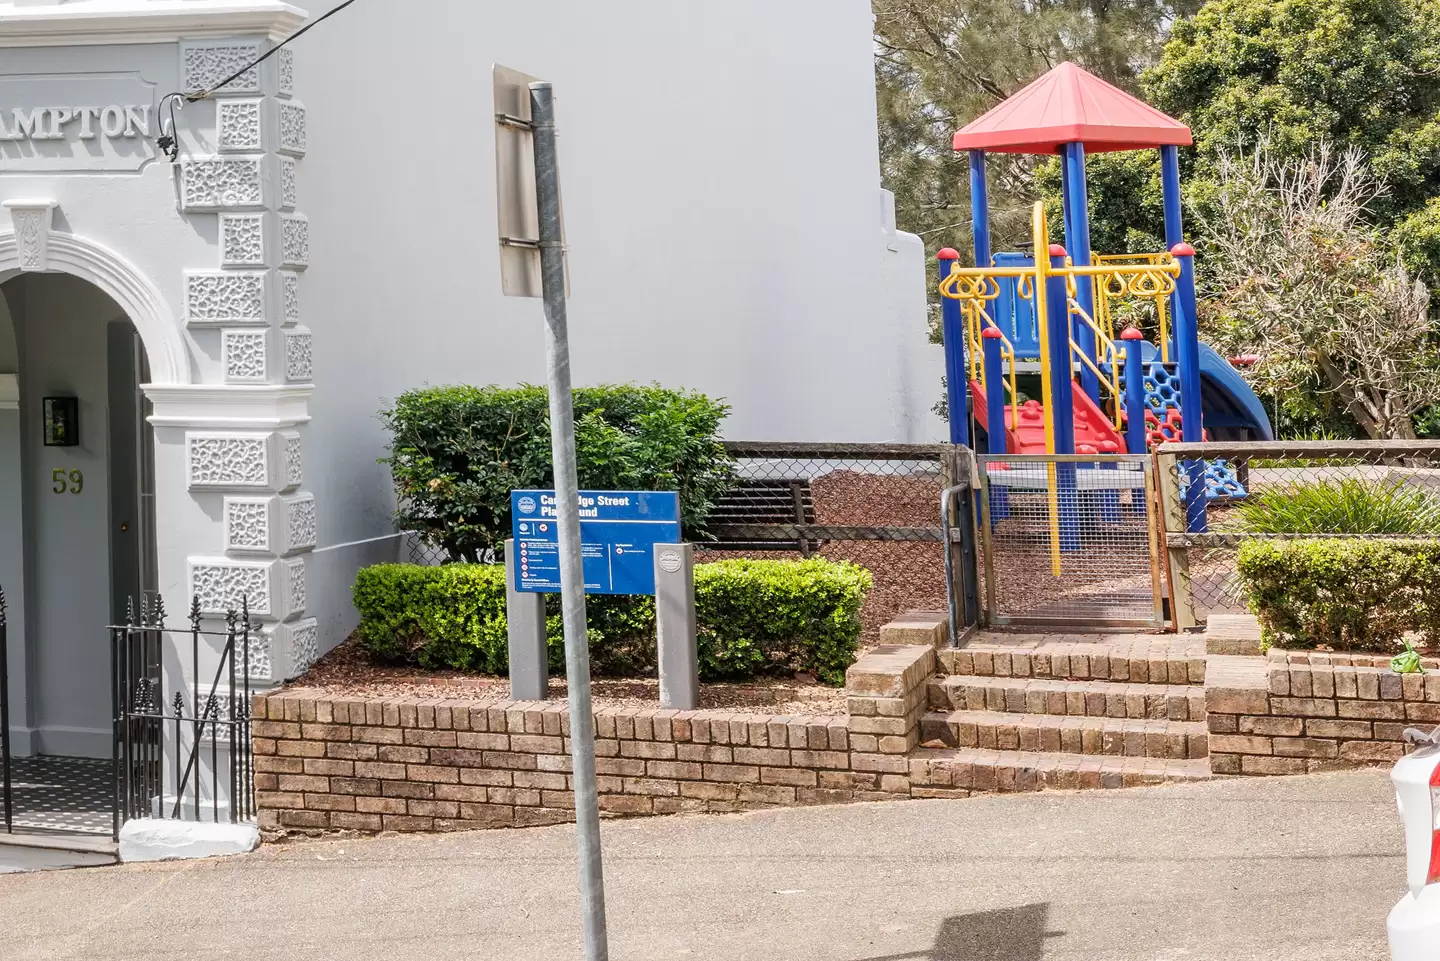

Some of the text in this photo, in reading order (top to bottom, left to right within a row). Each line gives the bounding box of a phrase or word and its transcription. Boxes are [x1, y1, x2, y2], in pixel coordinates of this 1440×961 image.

[52, 468, 83, 494] 59
[540, 495, 595, 507] Cadge
[597, 496, 630, 506] Street
[541, 507, 598, 517] Plaund
